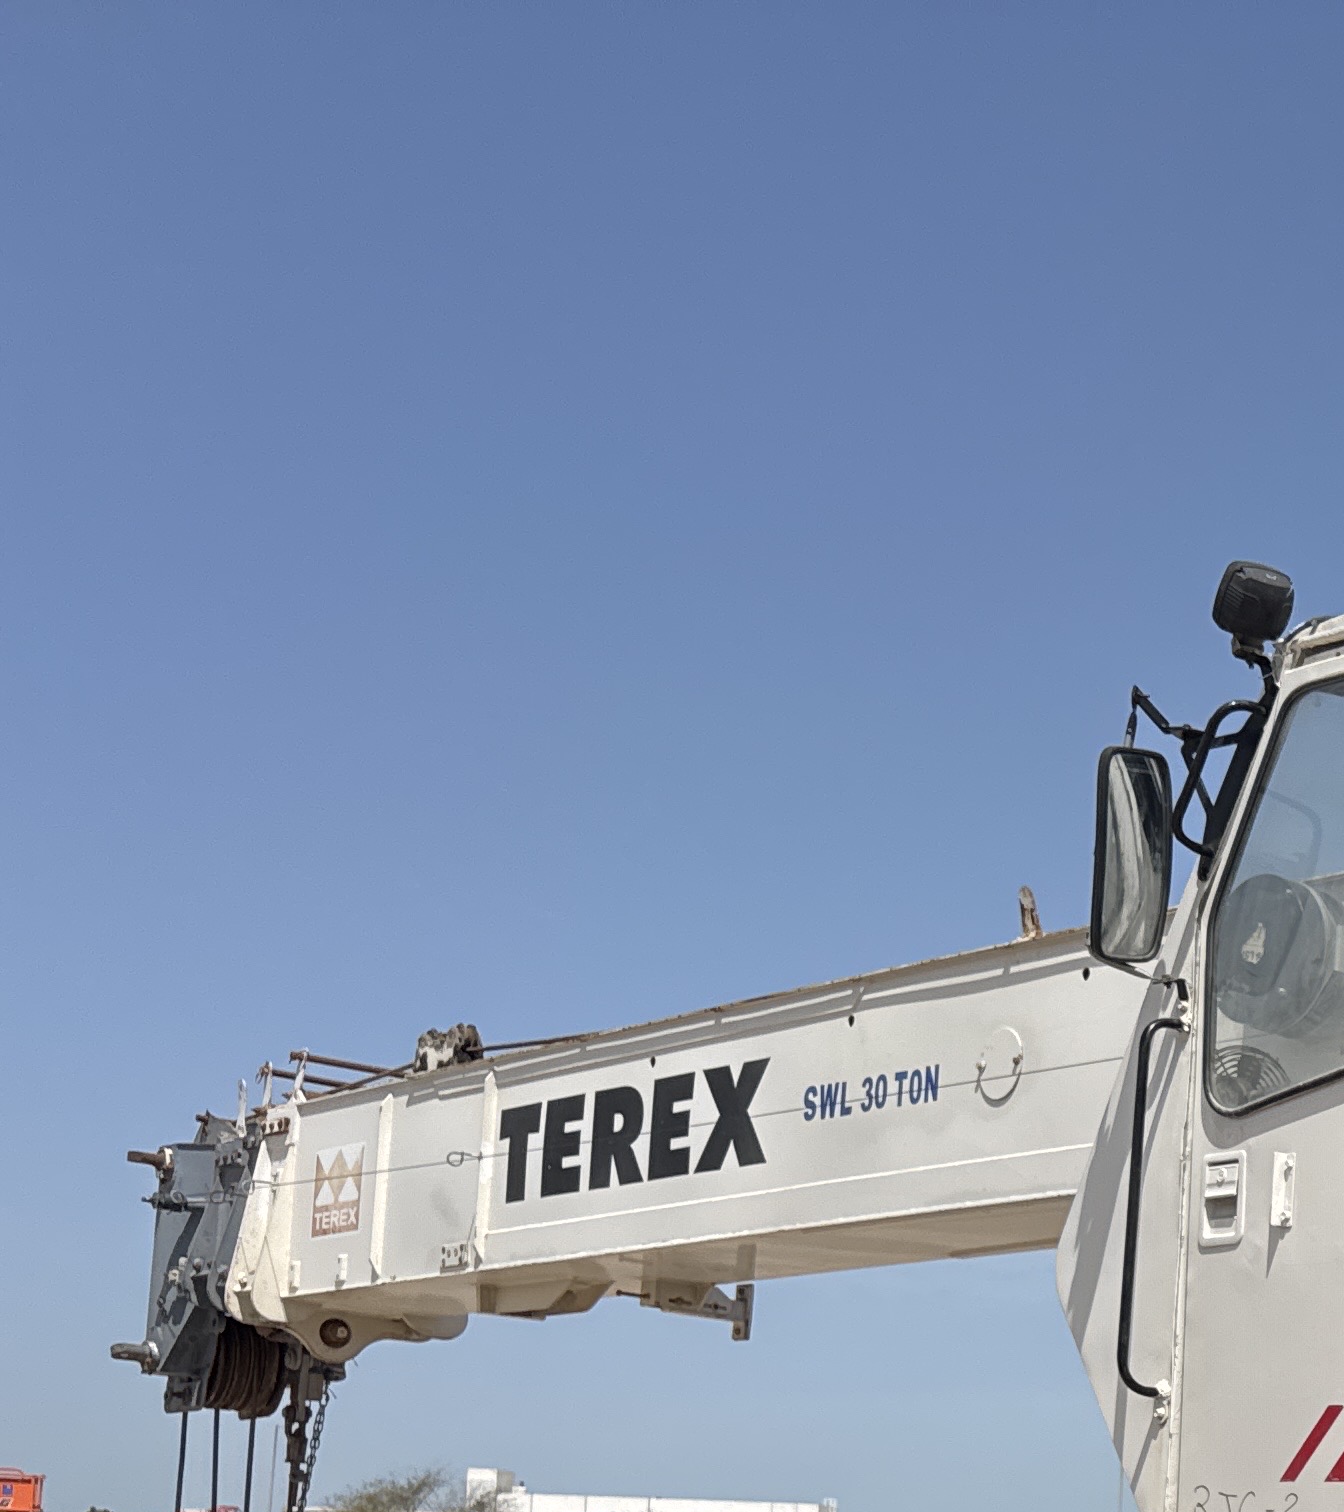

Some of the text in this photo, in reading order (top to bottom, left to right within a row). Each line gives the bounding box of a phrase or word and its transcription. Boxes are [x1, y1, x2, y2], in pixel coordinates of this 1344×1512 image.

[803, 1063, 940, 1121] SWL 30 TON
[500, 1057, 770, 1204] TEREX
[314, 1206, 358, 1231] TEREX
